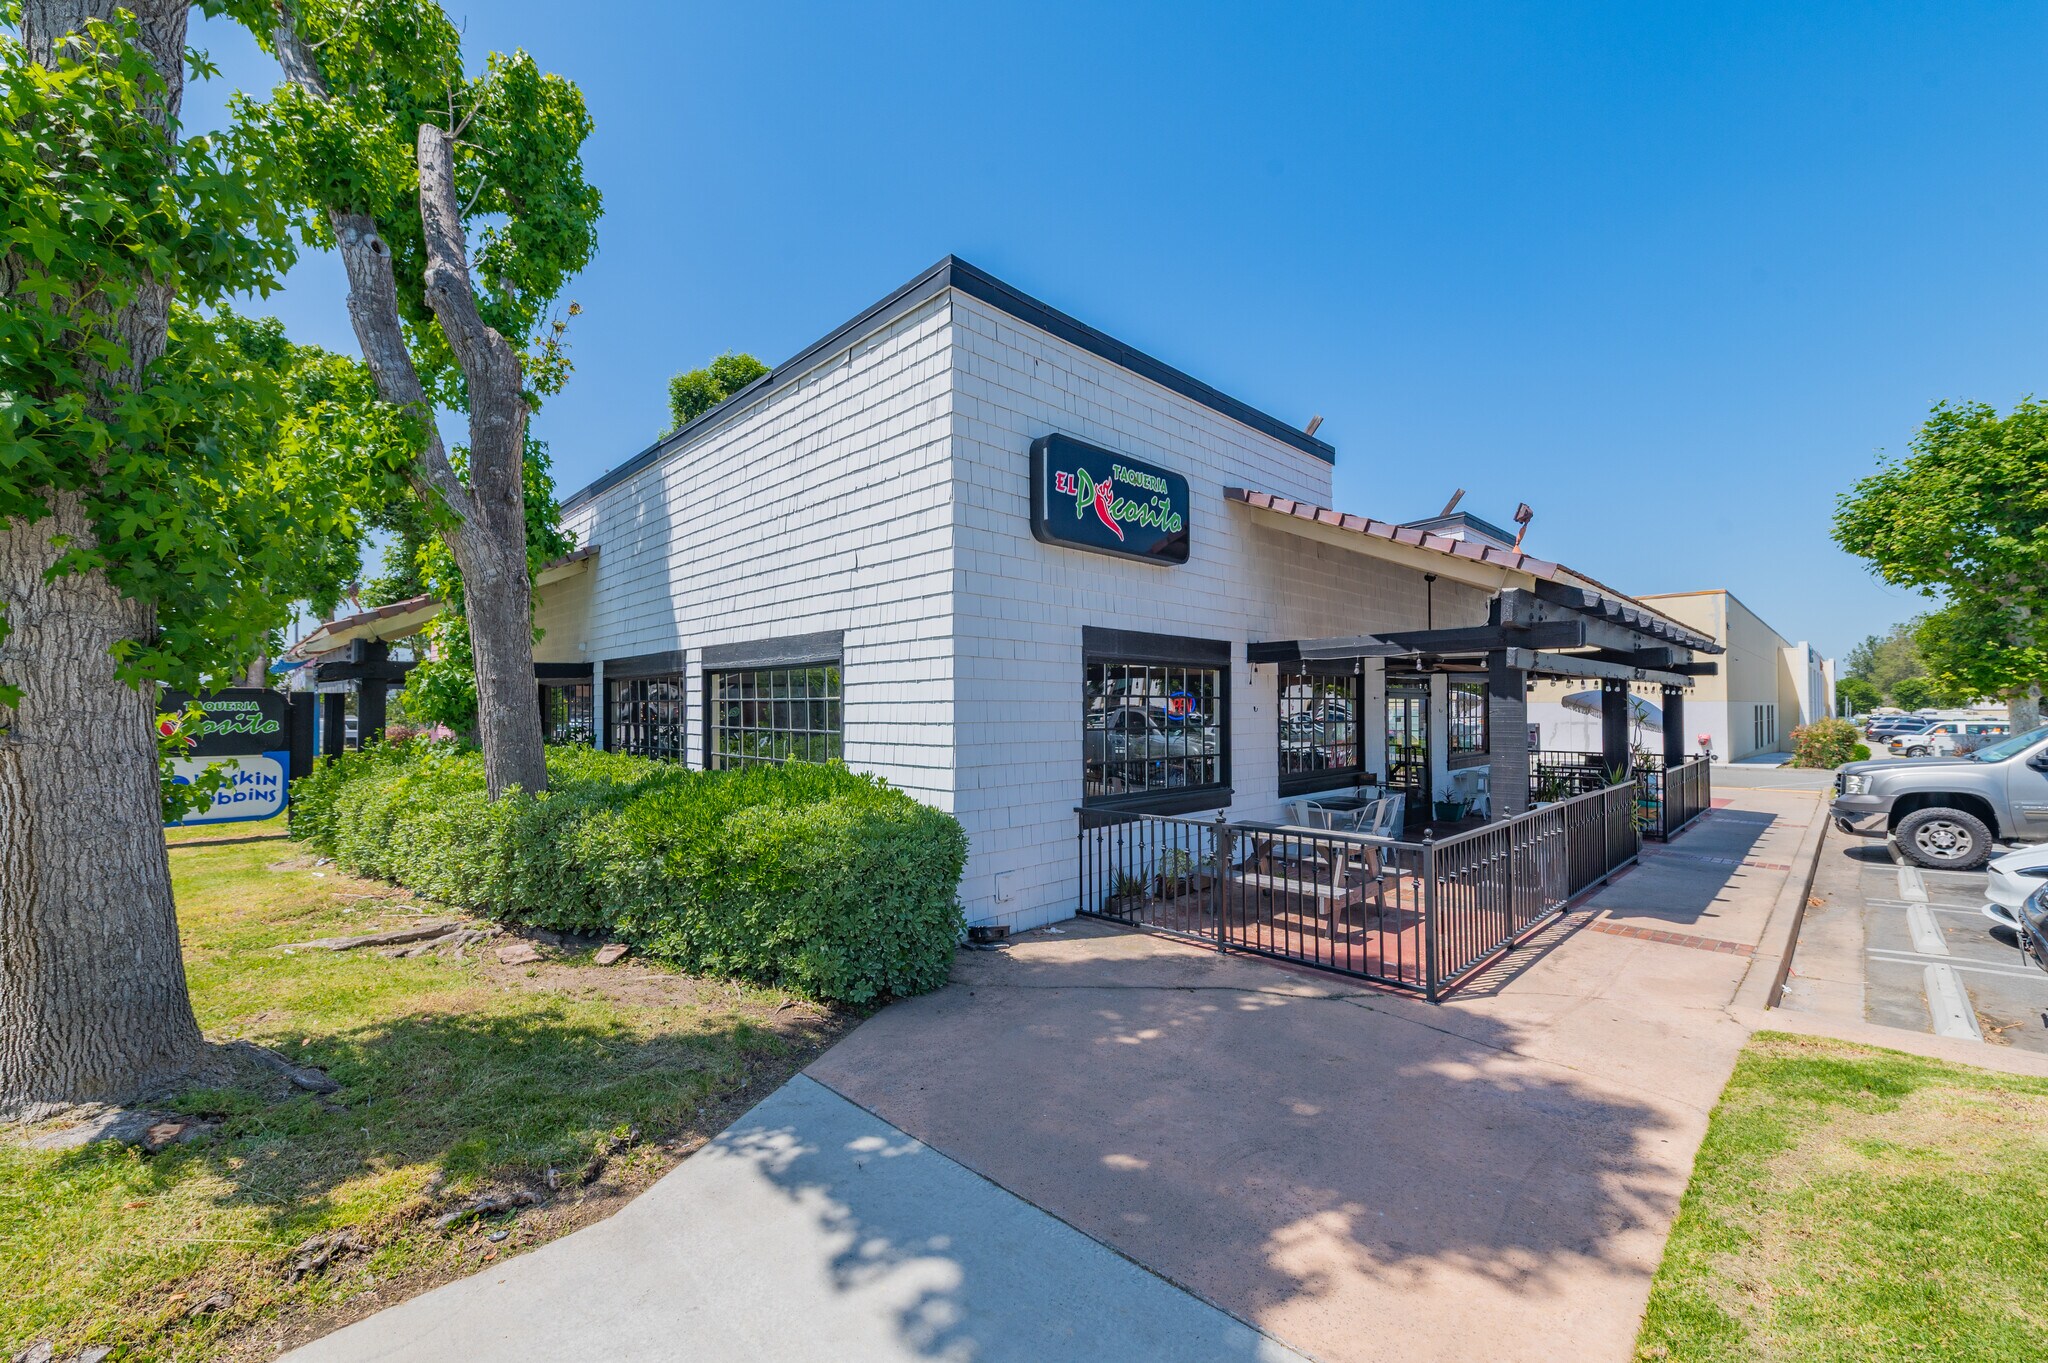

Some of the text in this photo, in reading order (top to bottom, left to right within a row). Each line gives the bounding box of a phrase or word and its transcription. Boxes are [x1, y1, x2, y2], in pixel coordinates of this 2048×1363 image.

[1055, 471, 1078, 496] EL
[1112, 464, 1168, 494] TAQUERIA
[183, 701, 260, 712] TQUERIA
